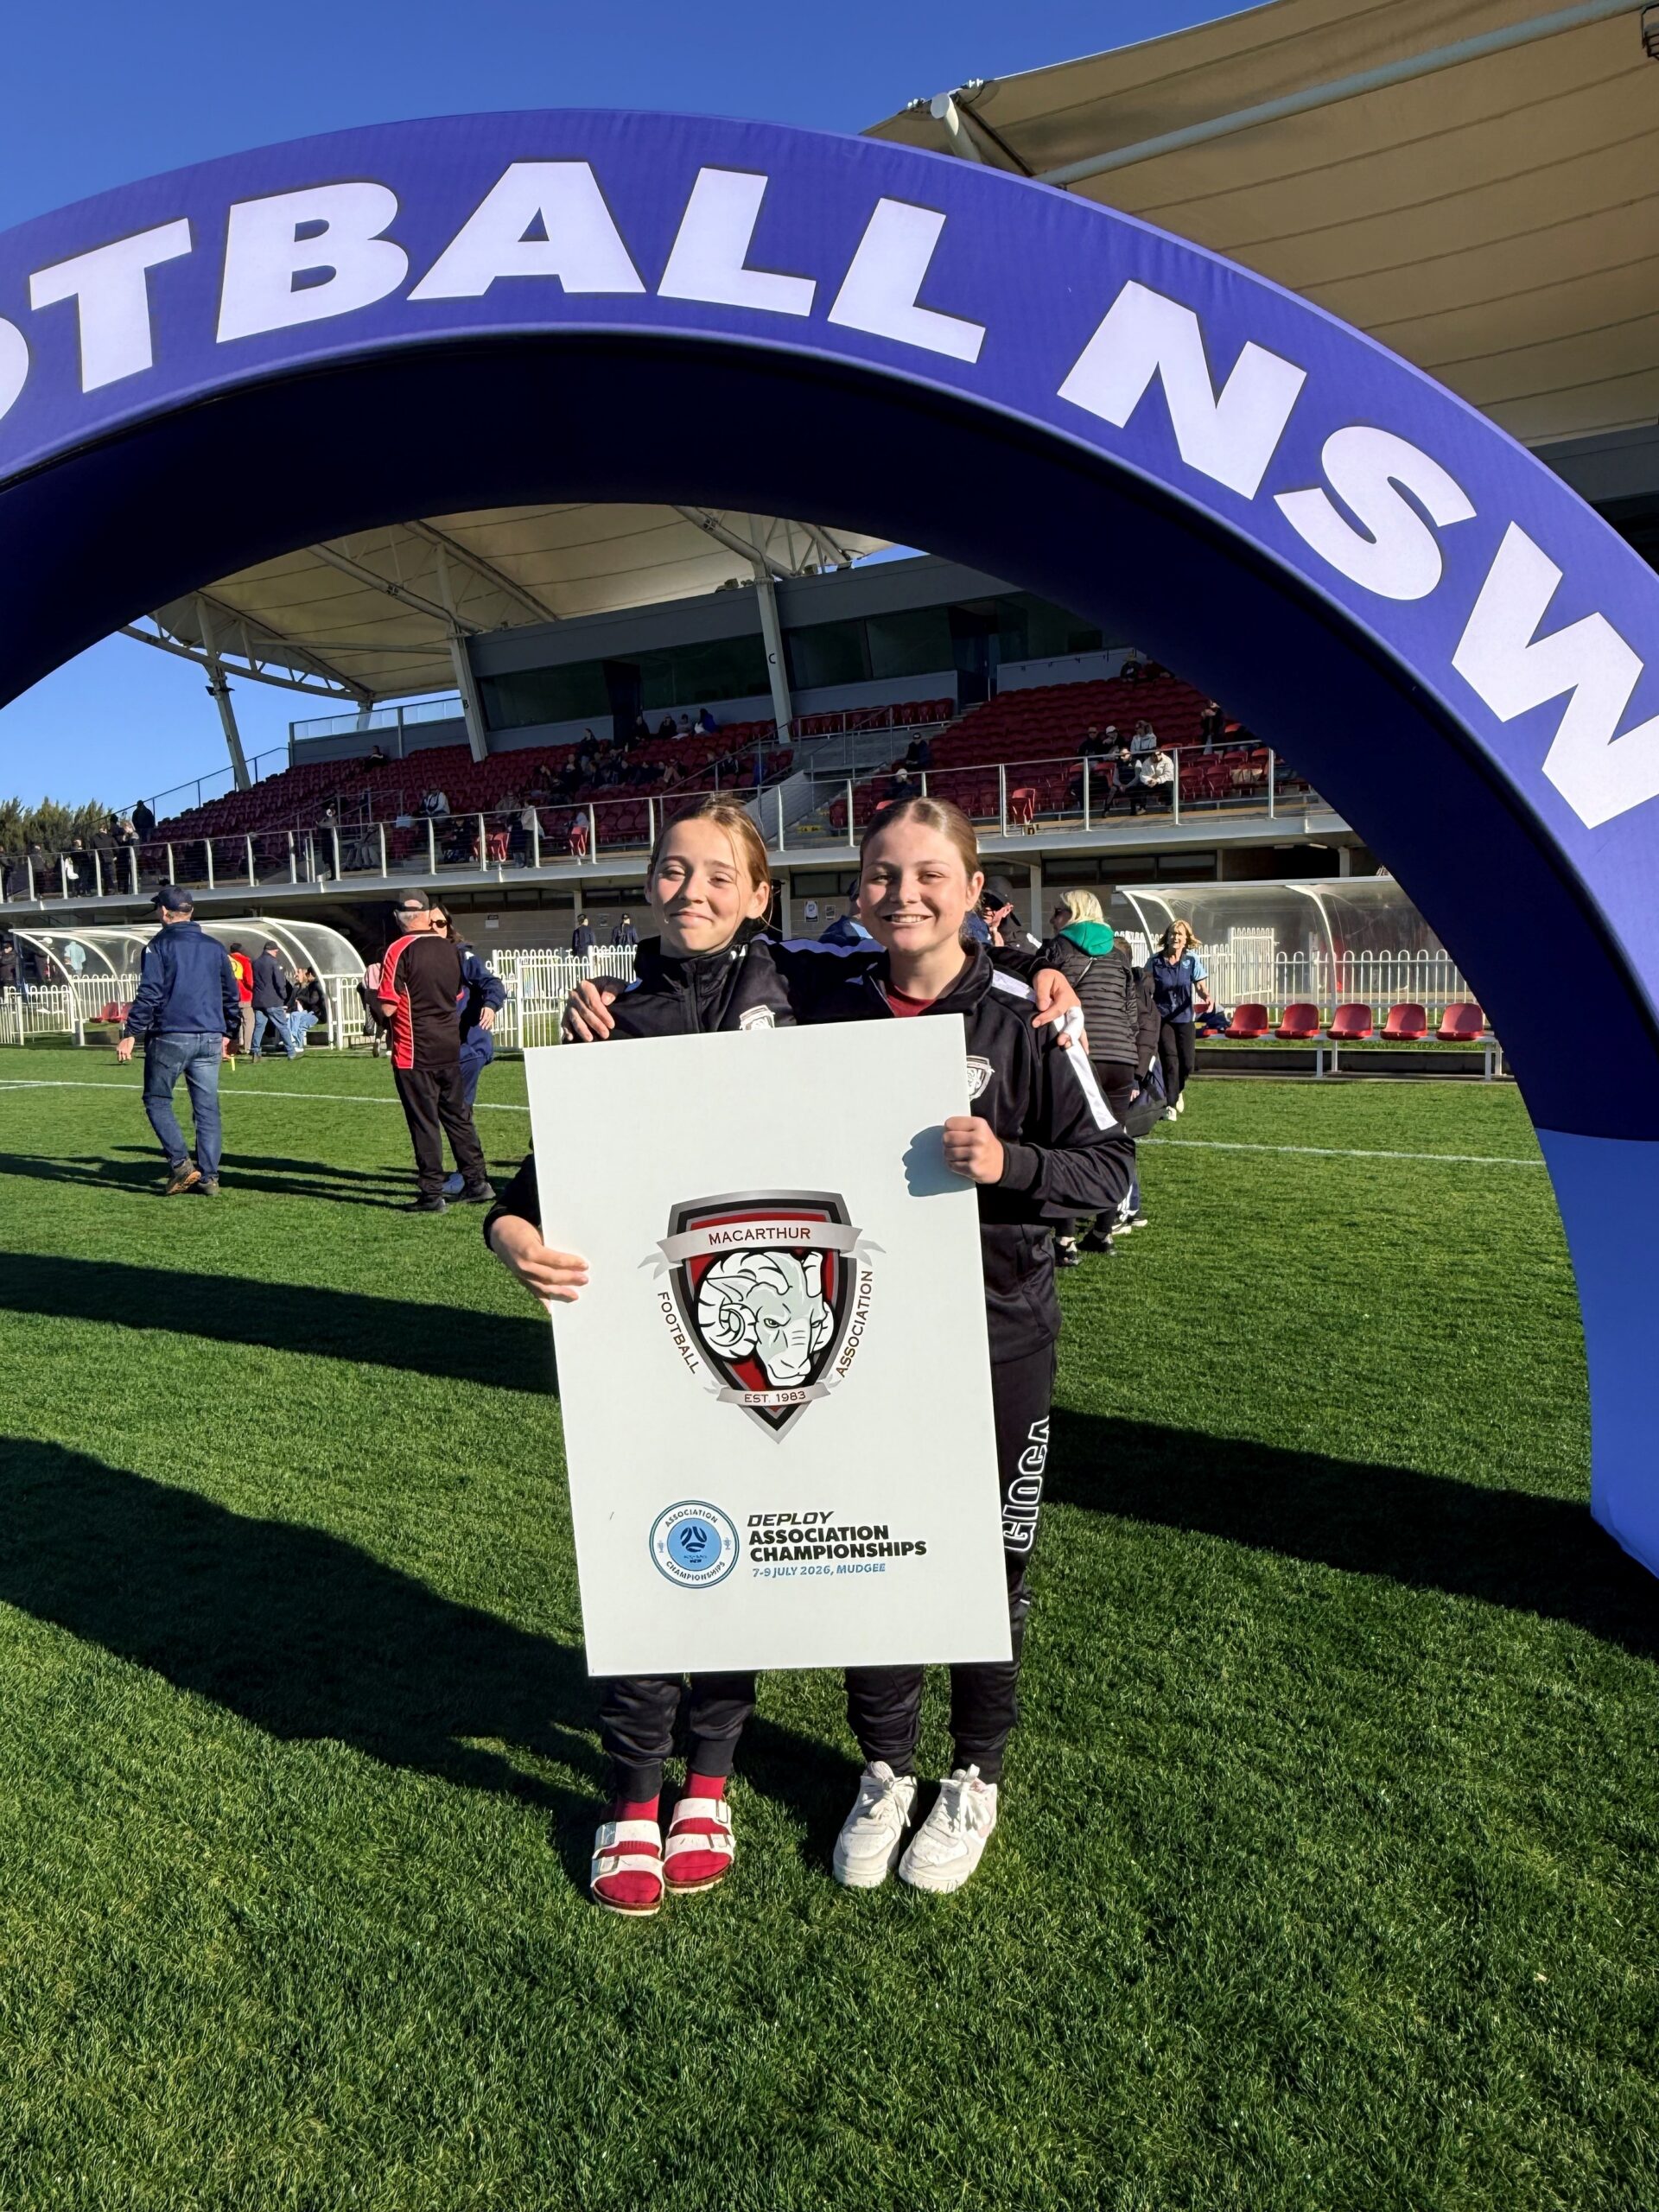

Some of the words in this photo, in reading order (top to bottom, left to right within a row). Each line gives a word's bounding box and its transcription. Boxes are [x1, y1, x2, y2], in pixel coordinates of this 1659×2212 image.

[0, 162, 986, 419] TBALL
[1056, 280, 1659, 830] NSW
[708, 1227, 811, 1246] MACARTHUR
[657, 1291, 698, 1374] FOOTBALL
[836, 1270, 873, 1378] ASSOCIATION
[744, 1394, 771, 1403] EST.
[776, 1390, 806, 1402] 1983
[664, 1509, 718, 1528] ASSOCIATION
[747, 1511, 835, 1527] DEPLOY
[748, 1525, 889, 1546] ASSOCIATION
[750, 1541, 927, 1562] CHAMPIONSHIPS
[665, 1560, 726, 1581] CHAMPIONSHIPS
[753, 1567, 771, 1578] 7-9
[772, 1567, 798, 1579] JULY
[800, 1565, 834, 1576] 2026,
[836, 1563, 886, 1574] MUDGEE
